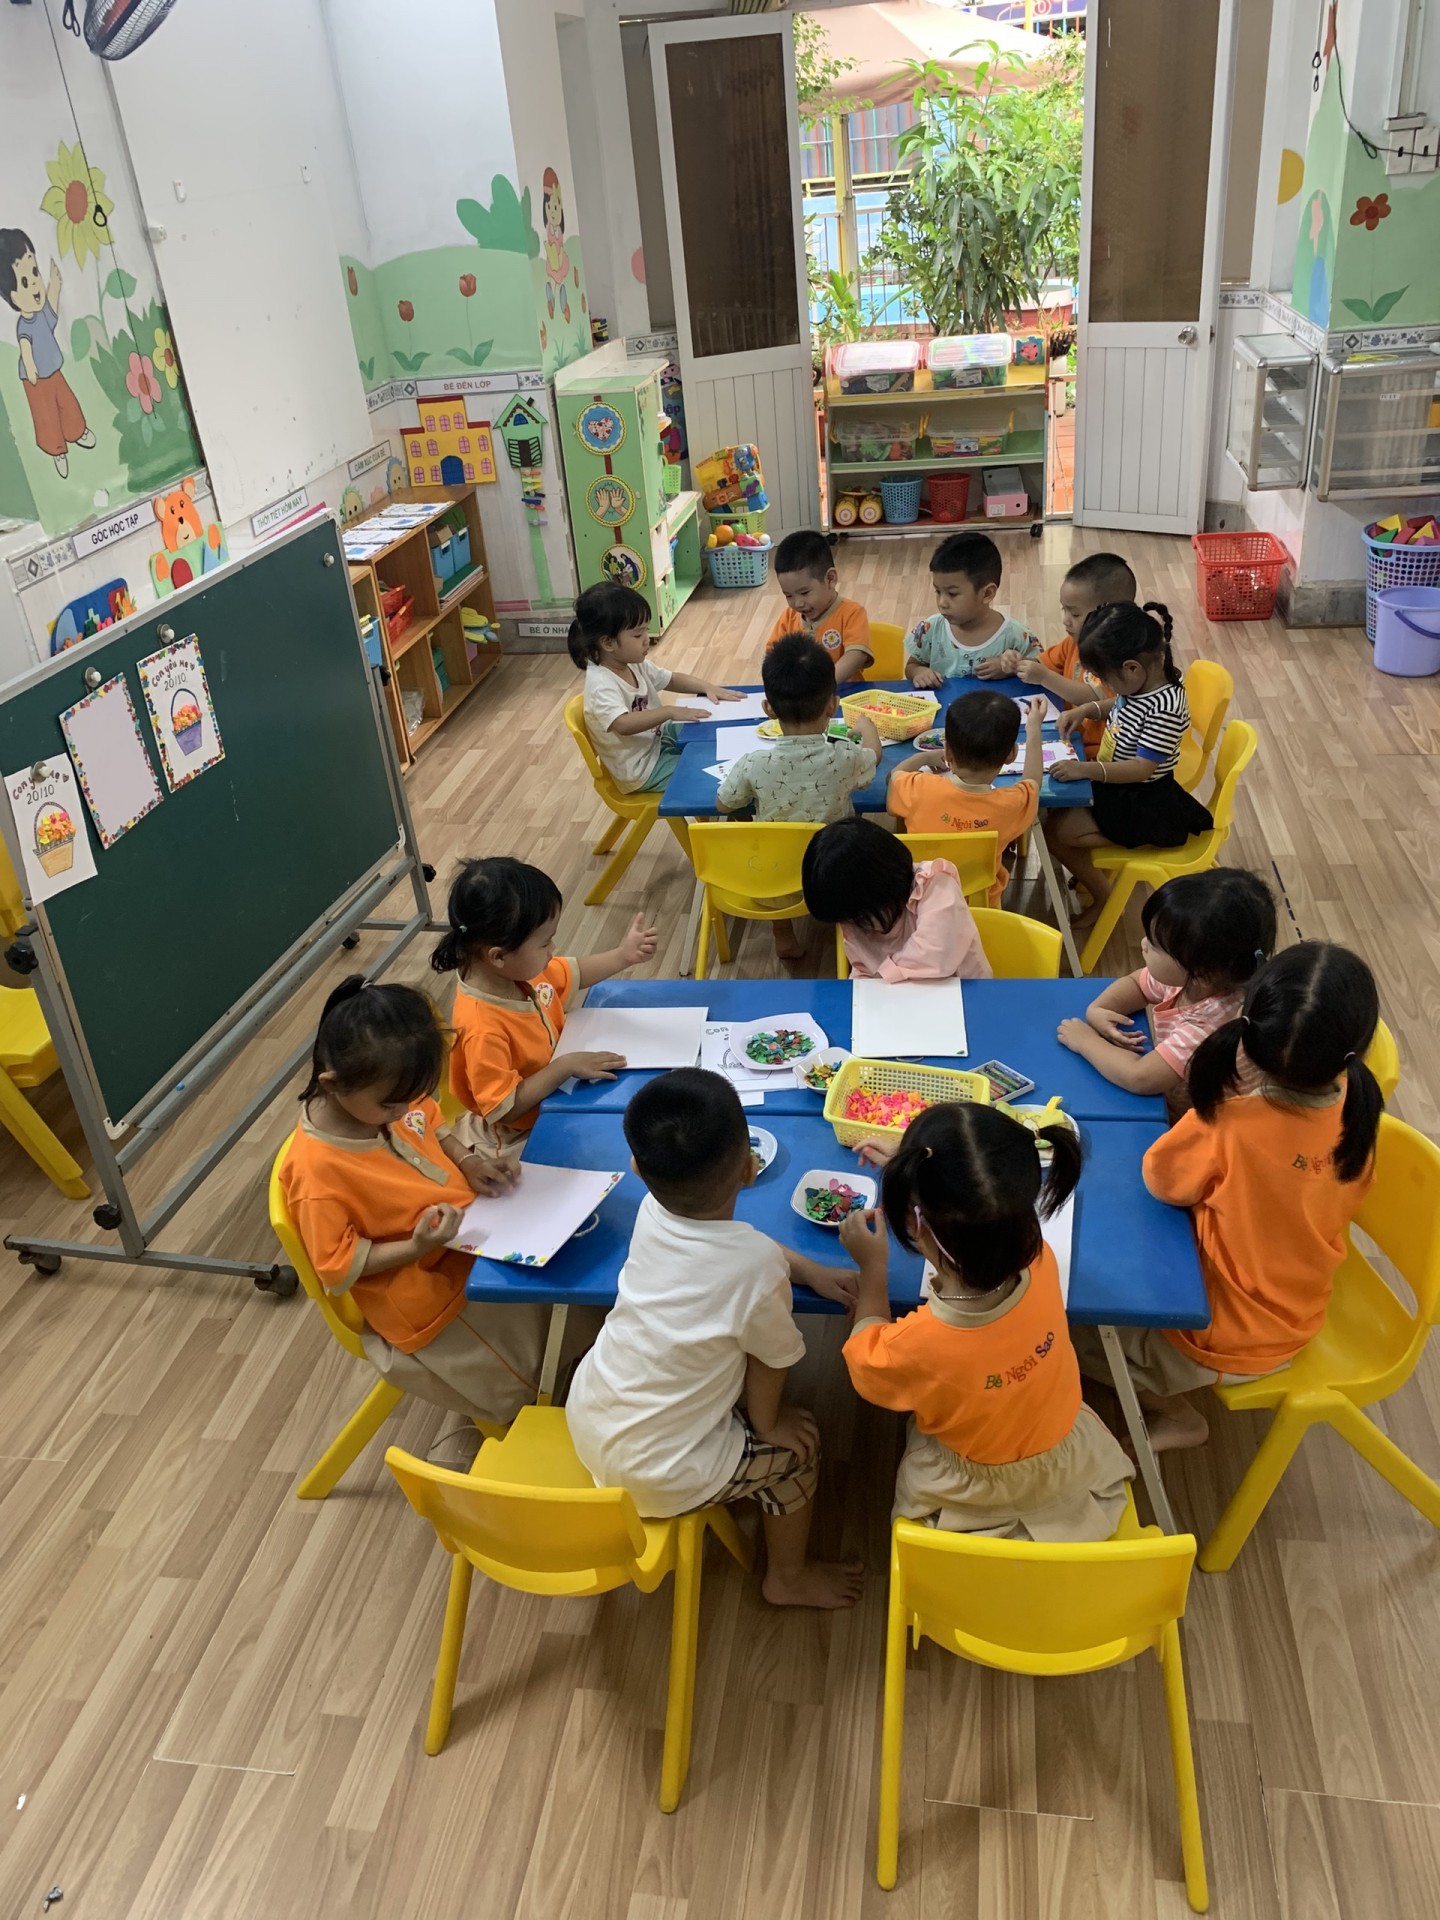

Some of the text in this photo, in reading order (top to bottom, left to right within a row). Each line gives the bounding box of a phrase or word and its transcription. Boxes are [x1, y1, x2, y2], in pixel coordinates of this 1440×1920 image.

[443, 382, 454, 390] BÉ
[91, 527, 109, 545] GÓC
[108, 520, 126, 536] HỌC
[529, 625, 541, 634] BÉ
[164, 672, 187, 691] 20/10
[26, 784, 55, 805] 20/10
[973, 819, 989, 829] Sao
[984, 1331, 1055, 1390] Bé Ngôi Sao
